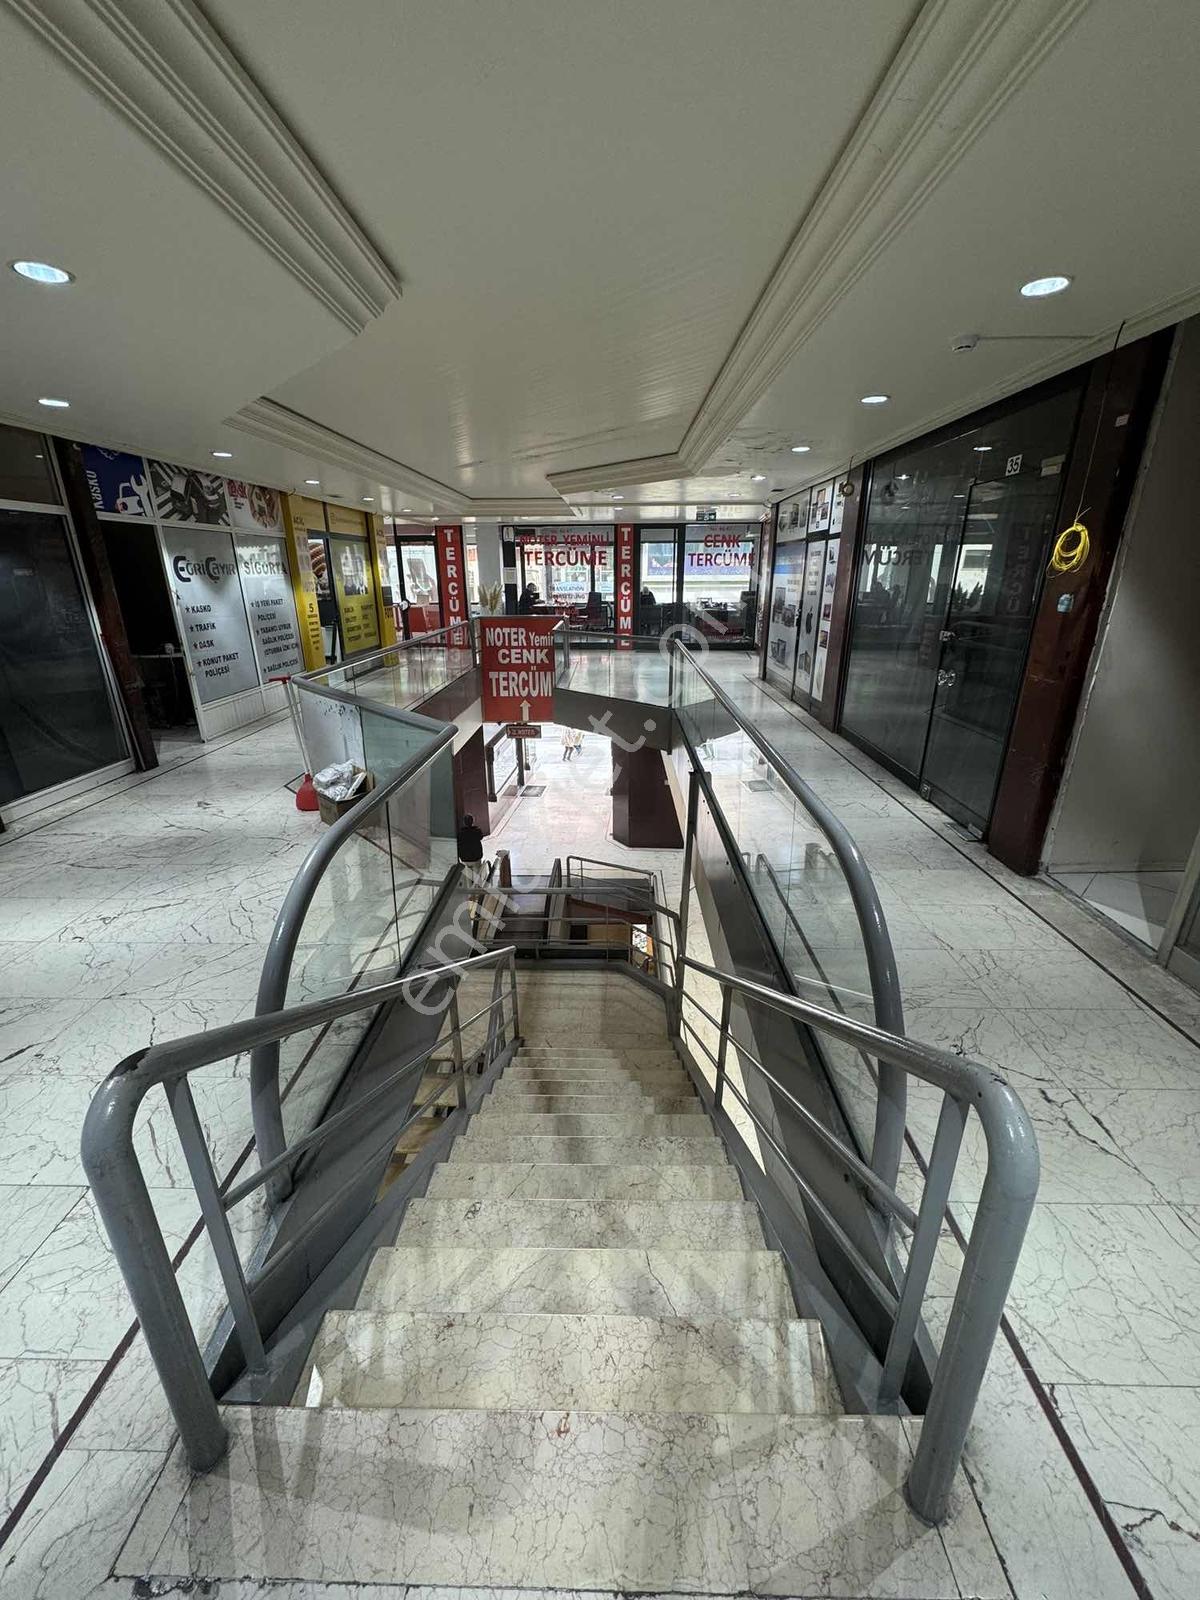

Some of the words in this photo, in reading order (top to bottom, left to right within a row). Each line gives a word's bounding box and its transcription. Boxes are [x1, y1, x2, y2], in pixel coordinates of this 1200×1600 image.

[1008, 457, 1020, 473] 35
[704, 534, 741, 548] CENK
[524, 547, 607, 566] TERCÜME
[191, 604, 212, 614] KASKO
[485, 627, 527, 647] NOTER
[203, 655, 222, 666] KONUT
[223, 652, 239, 662] PAKET
[497, 648, 549, 664] CENK
